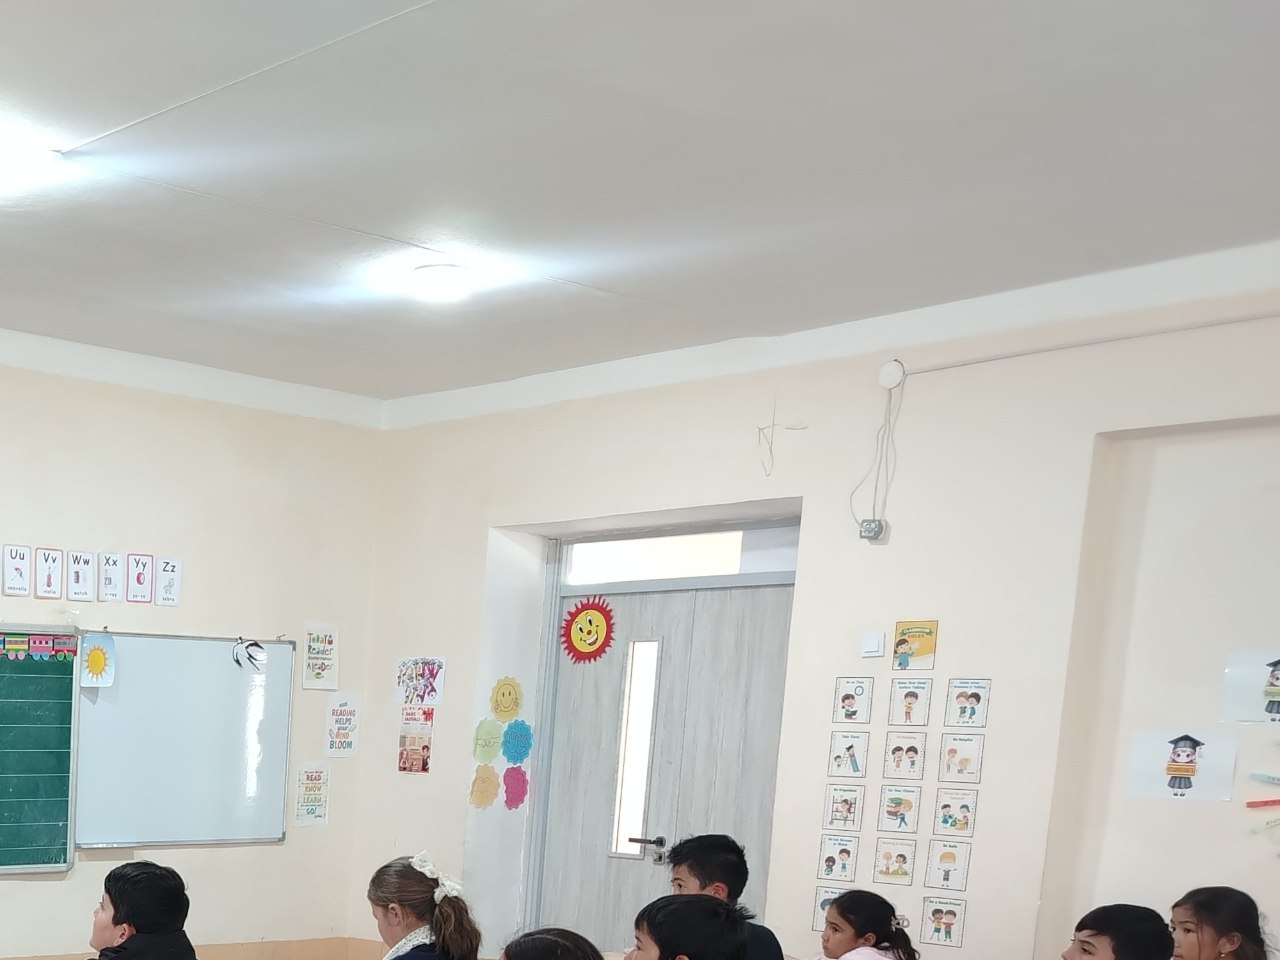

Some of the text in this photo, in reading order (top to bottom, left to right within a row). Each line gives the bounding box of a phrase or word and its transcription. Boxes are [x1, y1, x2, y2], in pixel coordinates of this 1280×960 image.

[10, 548, 25, 561] Uu
[43, 552, 57, 564] Vv
[71, 553, 90, 567] Ww
[104, 555, 118, 567] Xx
[133, 557, 147, 571] Yy
[162, 561, 176, 573] Zz
[329, 740, 352, 750] BLOOM
